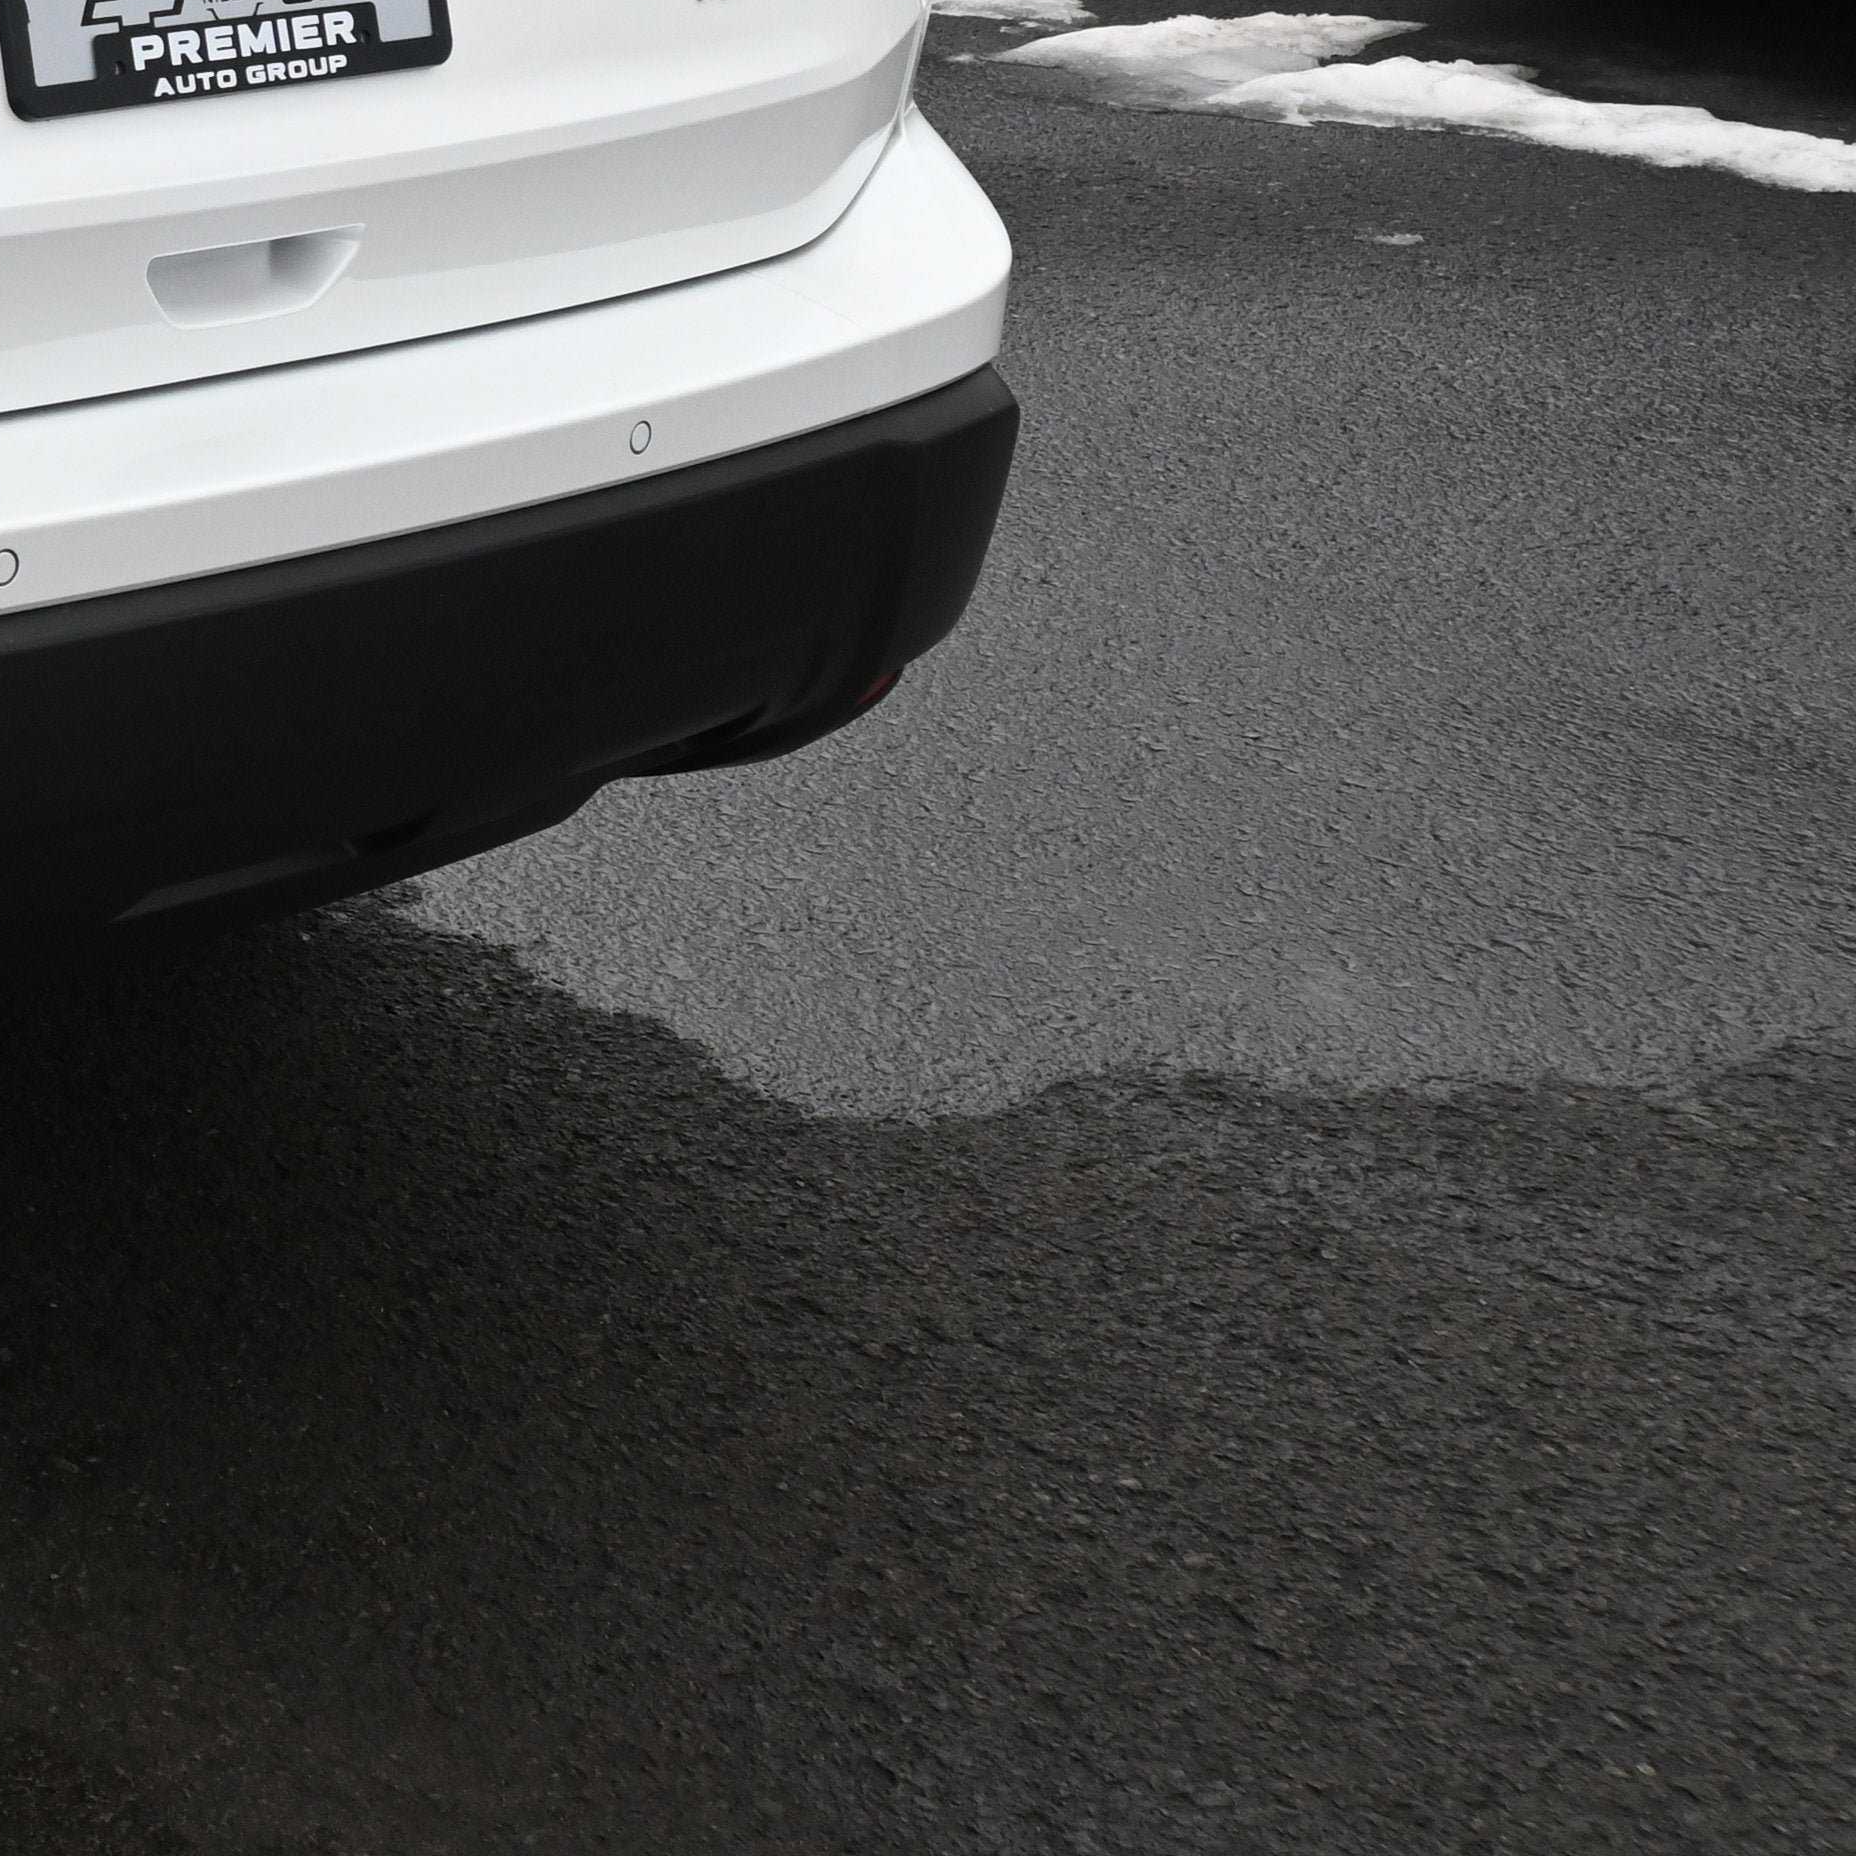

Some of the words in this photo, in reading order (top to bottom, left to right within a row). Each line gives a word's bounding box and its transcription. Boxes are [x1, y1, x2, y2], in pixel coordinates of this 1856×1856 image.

[131, 10, 357, 71] PREMIER
[154, 71, 237, 98] AUTO
[246, 53, 348, 84] GROUP
